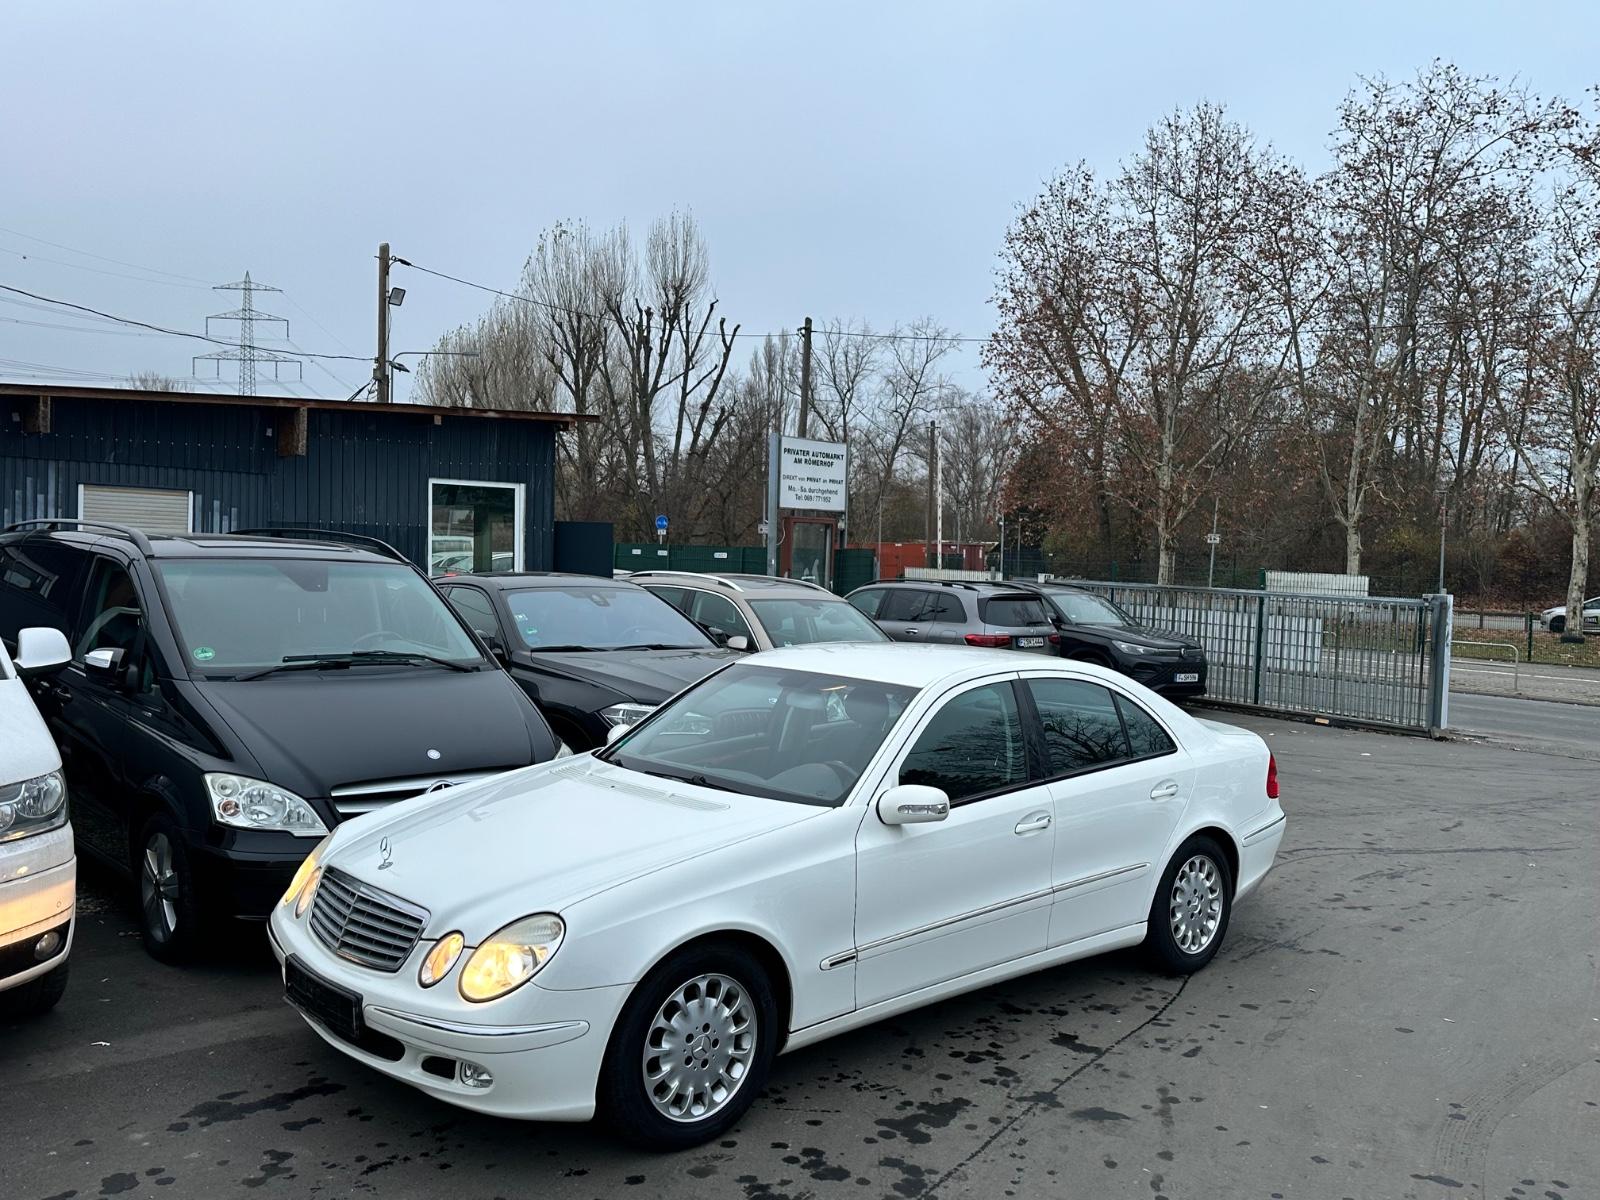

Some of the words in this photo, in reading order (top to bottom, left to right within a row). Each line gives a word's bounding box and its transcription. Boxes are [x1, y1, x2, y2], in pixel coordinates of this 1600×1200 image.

[784, 448, 810, 456] PRIVATER
[811, 451, 844, 460] AUTOMARKT
[804, 458, 834, 468] RÖMERHOF
